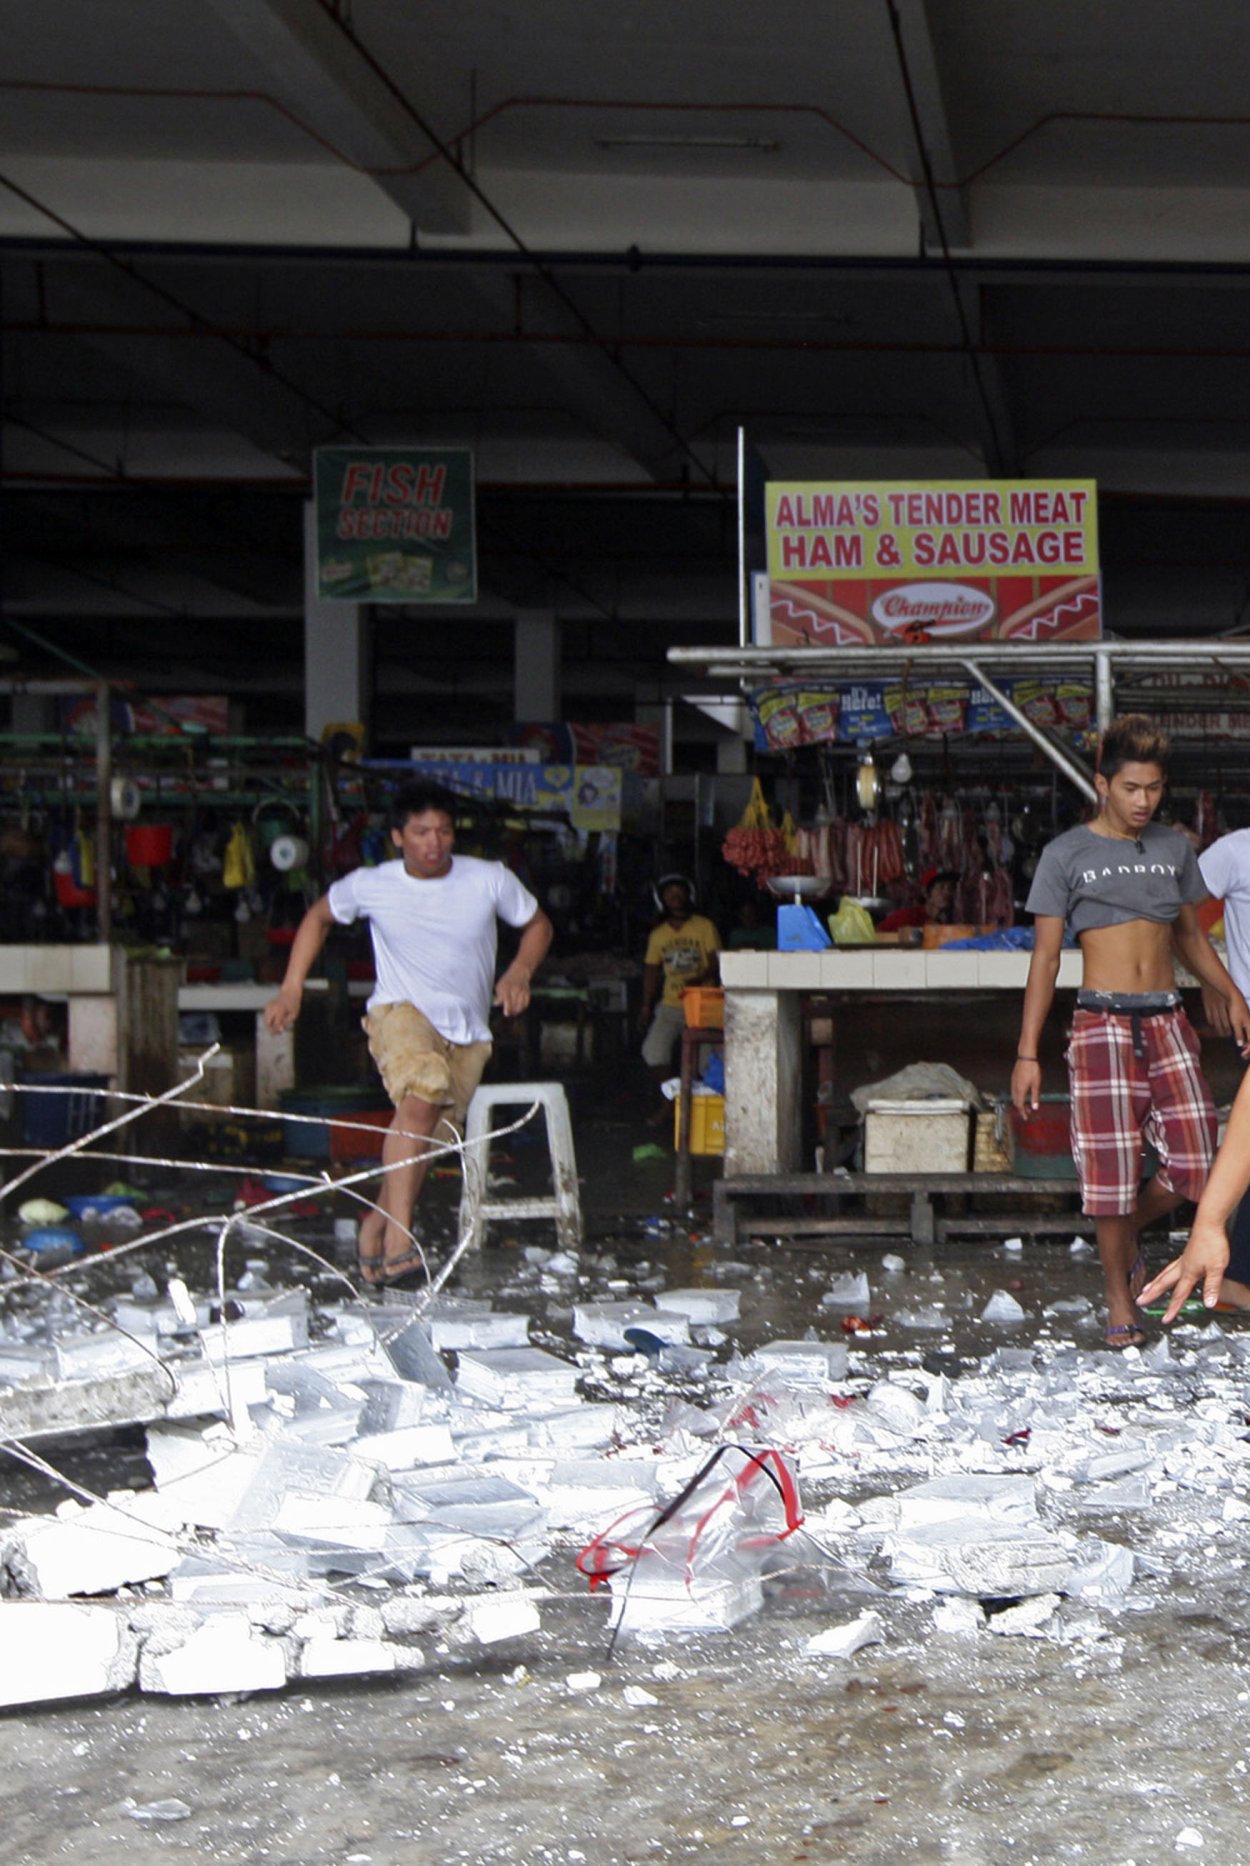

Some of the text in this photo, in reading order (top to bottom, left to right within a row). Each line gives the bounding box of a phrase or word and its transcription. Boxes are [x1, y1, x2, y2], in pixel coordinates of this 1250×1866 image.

[343, 463, 446, 504] FISH
[337, 509, 453, 540] SECTION
[776, 491, 1087, 528] ALMA'S TENDER MEAT
[782, 531, 1084, 568] HAM & SAUSAGE
[884, 595, 983, 620] Champion
[496, 771, 537, 804] MIA
